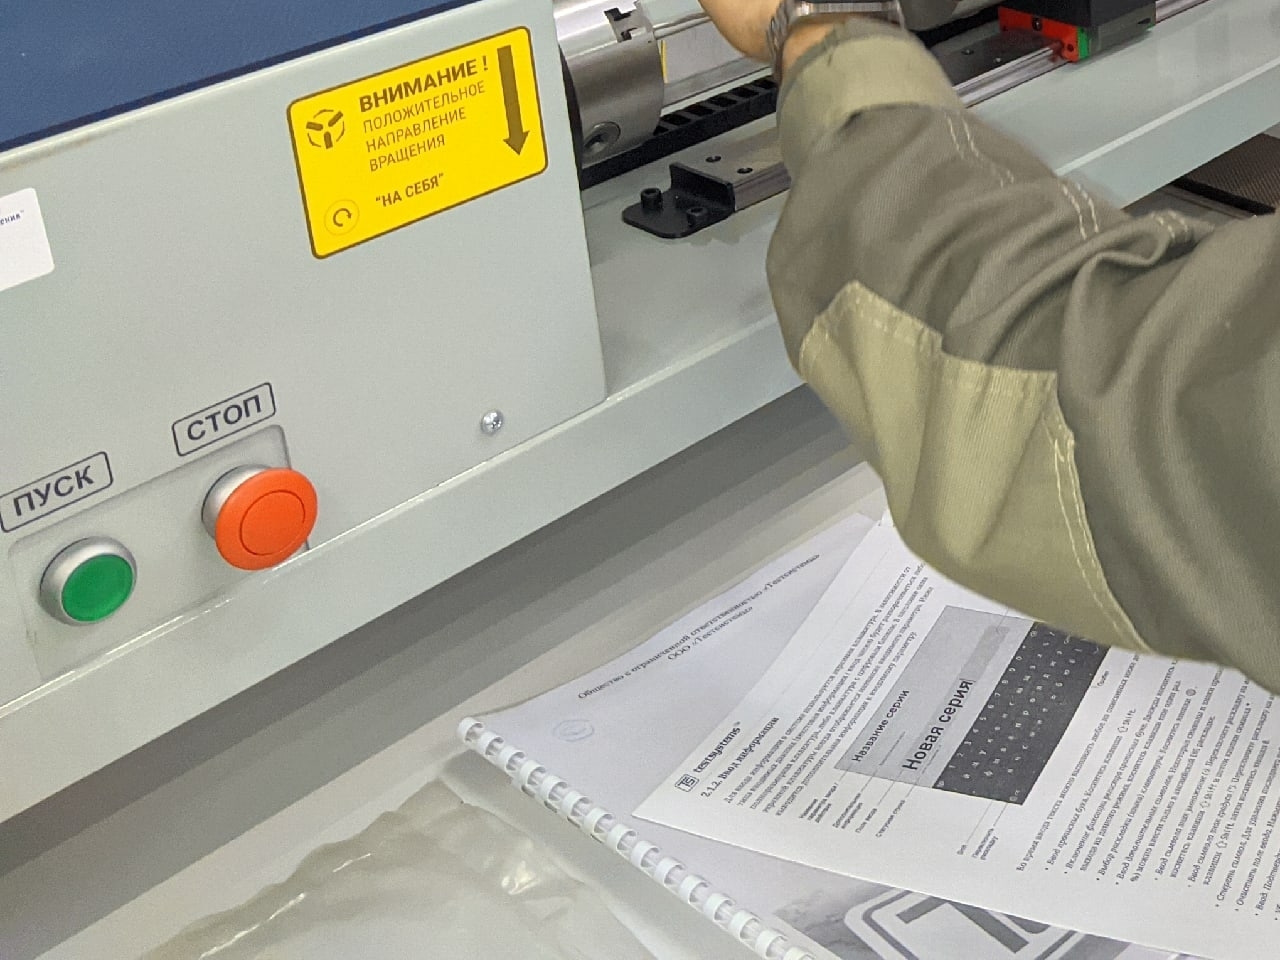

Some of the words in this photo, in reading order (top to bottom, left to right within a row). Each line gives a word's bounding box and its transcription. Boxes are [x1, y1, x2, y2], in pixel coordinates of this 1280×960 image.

[359, 58, 478, 113] ВНИМАНИЕ
[362, 79, 486, 133] ПОЛОЖИТЕЛЬНОЕ
[366, 106, 467, 153] НАПРАВЛЕНИЕ
[369, 134, 446, 173] ВРАЩЕНИЯ
[186, 394, 262, 441] СТОП
[13, 465, 95, 517] ПУСК
[715, 760, 741, 780] Ввод
[730, 715, 783, 763] информации
[850, 717, 890, 763] Название
[881, 688, 913, 719] серии
[899, 723, 945, 771] Новая
[932, 678, 978, 725] серия
[1115, 861, 1131, 880] Ввод
[1154, 856, 1169, 875] Ввод
[1187, 863, 1202, 882] Ввод
